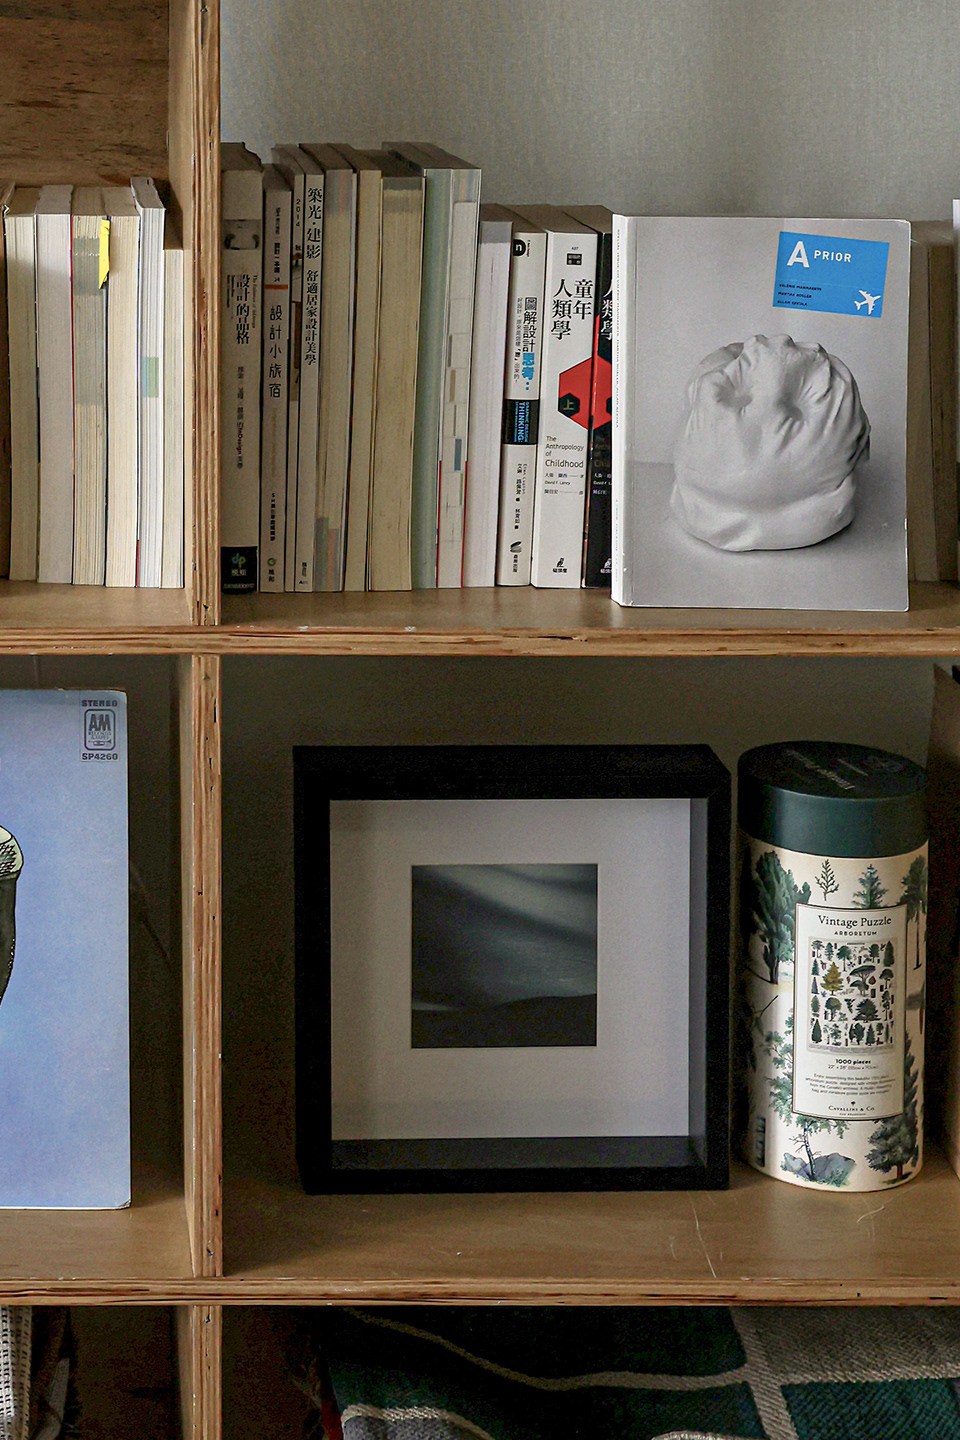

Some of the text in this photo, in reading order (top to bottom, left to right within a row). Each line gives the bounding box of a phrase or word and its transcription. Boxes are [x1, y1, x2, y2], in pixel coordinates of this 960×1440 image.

[787, 241, 852, 268] A PRIOR
[236, 274, 250, 345] 設計的品格
[551, 278, 572, 340] 人類學
[573, 278, 594, 320] 童年
[304, 269, 320, 367] 舒適居家設計美學
[269, 305, 282, 399] 設計小旅宿
[563, 398, 575, 411] 上
[545, 460, 583, 468] Childhood
[546, 443, 584, 451] Anthropology
[818, 915, 891, 929] Vintage Puzzle
